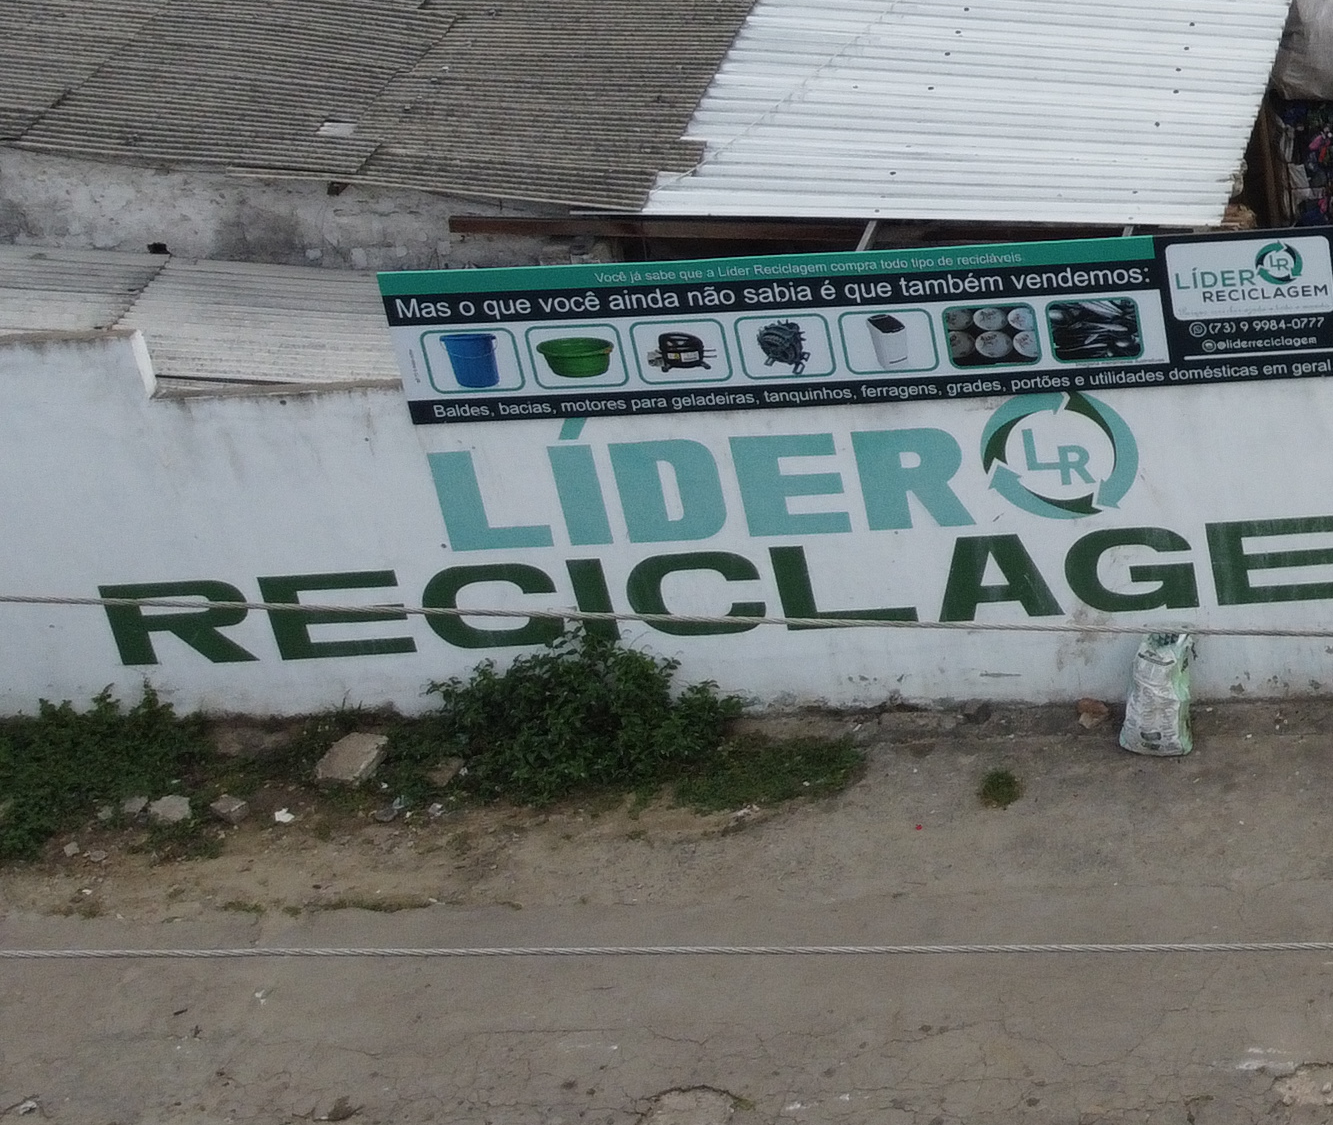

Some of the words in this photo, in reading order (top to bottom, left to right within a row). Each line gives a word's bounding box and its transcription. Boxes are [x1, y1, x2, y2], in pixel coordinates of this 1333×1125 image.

[595, 272, 628, 284] Você
[630, 270, 642, 283] já
[645, 269, 676, 281] sabe
[679, 269, 703, 282] que
[706, 269, 715, 278] a
[718, 265, 750, 278] Líder
[754, 262, 827, 278] Reciclagem
[831, 260, 877, 274] compra
[880, 257, 907, 269] todo
[912, 255, 934, 270] tipo
[937, 254, 953, 267] de
[957, 252, 1022, 266] recicláveis
[1174, 267, 1256, 290] LÍDER
[1269, 255, 1289, 271] LR
[395, 297, 452, 320] Mas
[459, 300, 475, 317] o
[483, 296, 532, 321] que
[538, 291, 601, 315] você
[608, 289, 680, 311] ainda
[687, 286, 736, 308] não
[743, 281, 813, 304] sabia
[820, 279, 836, 300] é
[844, 280, 893, 304] que
[900, 272, 1004, 297] também
[1010, 266, 1150, 291] vendemos:
[1202, 284, 1329, 303] RECICLAGEM
[1208, 321, 1237, 335] (73)
[1240, 320, 1249, 332] 9
[1253, 316, 1325, 331] 9984-0777
[1217, 336, 1317, 351] @liderreciclagem
[433, 403, 495, 420] Baldes,
[500, 401, 557, 417] bacias,
[561, 397, 626, 413] motores
[631, 397, 668, 412] para
[671, 391, 760, 410] geladeiras,
[763, 386, 857, 404] tanquinhos,
[860, 382, 942, 401] ferragens,
[946, 377, 1006, 395] grades,
[1010, 375, 1071, 393] portões
[1074, 375, 1085, 387] e
[1089, 368, 1164, 387] utilidades
[1168, 362, 1258, 382] domésticas
[1262, 363, 1288, 376] em
[427, 417, 978, 552] LÍDER
[1021, 428, 1097, 487] LR
